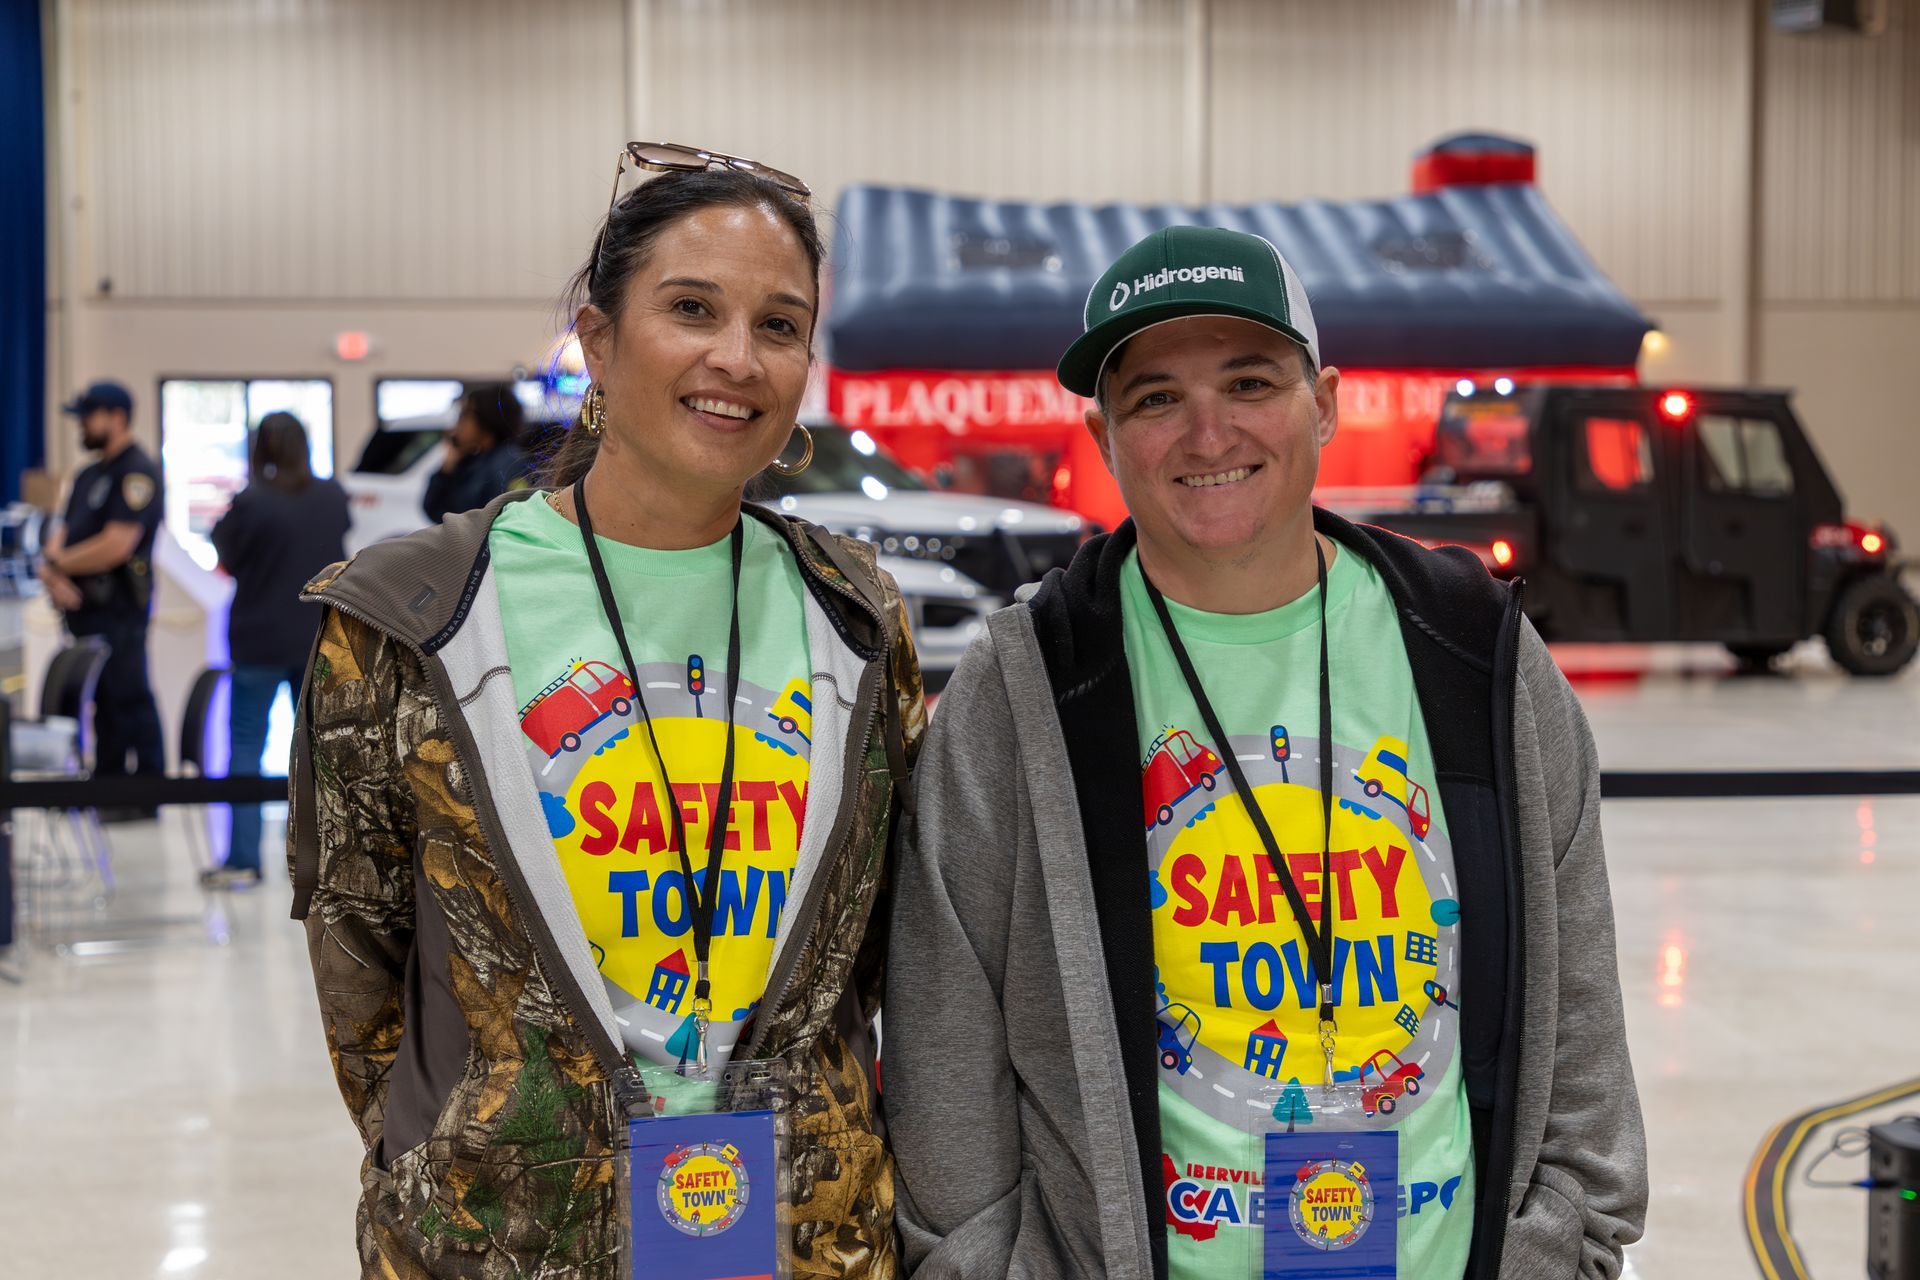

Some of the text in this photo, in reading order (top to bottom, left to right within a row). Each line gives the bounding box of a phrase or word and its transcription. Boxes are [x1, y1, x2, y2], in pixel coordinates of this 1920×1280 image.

[1133, 265, 1245, 296] Hidrogenii
[429, 569, 481, 648] THREADBORNE
[1170, 844, 1407, 927] SAFETY
[1199, 934, 1399, 1011] TOWN
[676, 1171, 729, 1190] SAFETY
[683, 1191, 725, 1207] TOWN
[1305, 1187, 1357, 1204] SAFETY
[1311, 1204, 1352, 1222] TOWN
